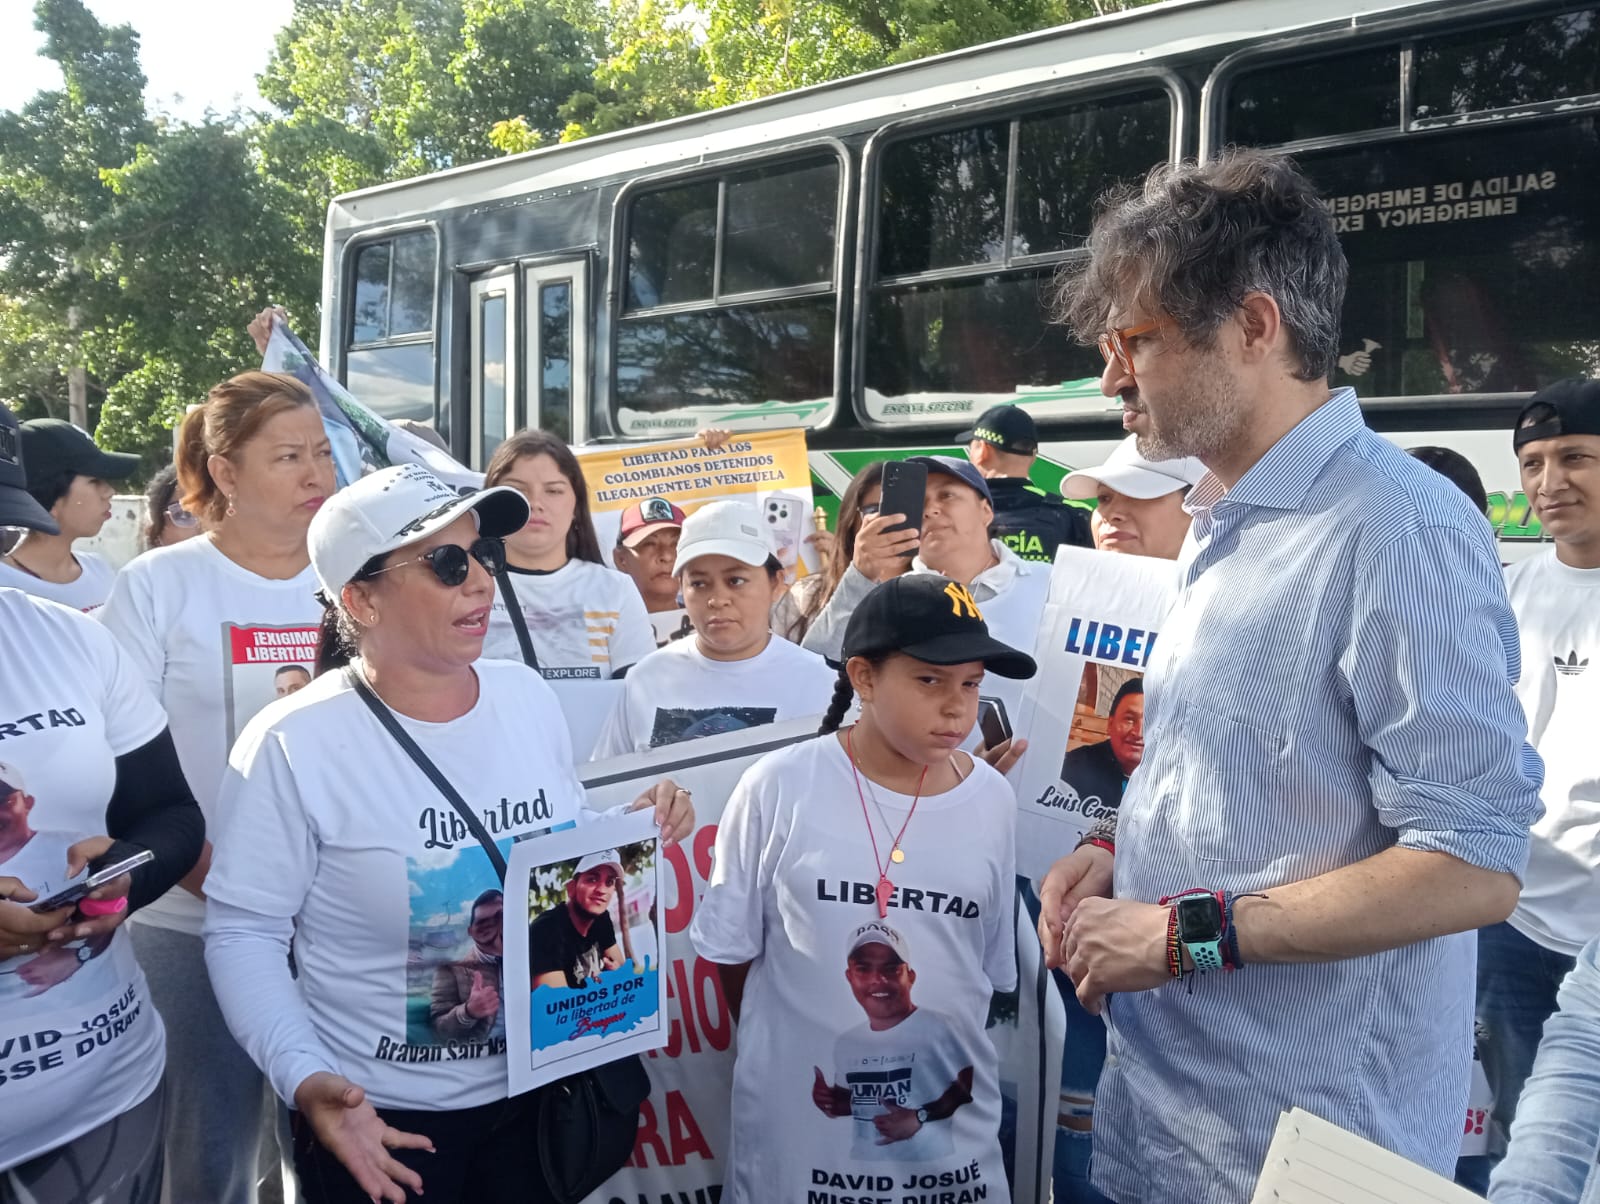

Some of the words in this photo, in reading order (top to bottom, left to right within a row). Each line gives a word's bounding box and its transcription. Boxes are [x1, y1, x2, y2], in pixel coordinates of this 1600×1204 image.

[604, 463, 702, 485] COLOMBIANOS
[704, 455, 774, 472] DETENIDOS
[621, 449, 689, 467] LIBERTAD
[729, 442, 752, 453] LOS
[597, 481, 693, 502] ILEGALMENTE
[695, 478, 713, 488] EN
[714, 470, 785, 486] VENEZUELA
[246, 646, 316, 661] LIBERTAD
[546, 668, 597, 679] EXPLORE
[419, 788, 553, 850] Librtad
[817, 879, 979, 918] LIBERTAD
[546, 987, 608, 1015] UNIDOS
[613, 976, 644, 995] POR
[556, 1014, 567, 1025] la
[571, 997, 618, 1020] libertad
[621, 993, 635, 1006] de
[851, 1079, 911, 1098] UMAN
[812, 1168, 893, 1191] DAVID
[902, 1158, 981, 1189] JOSUÉ
